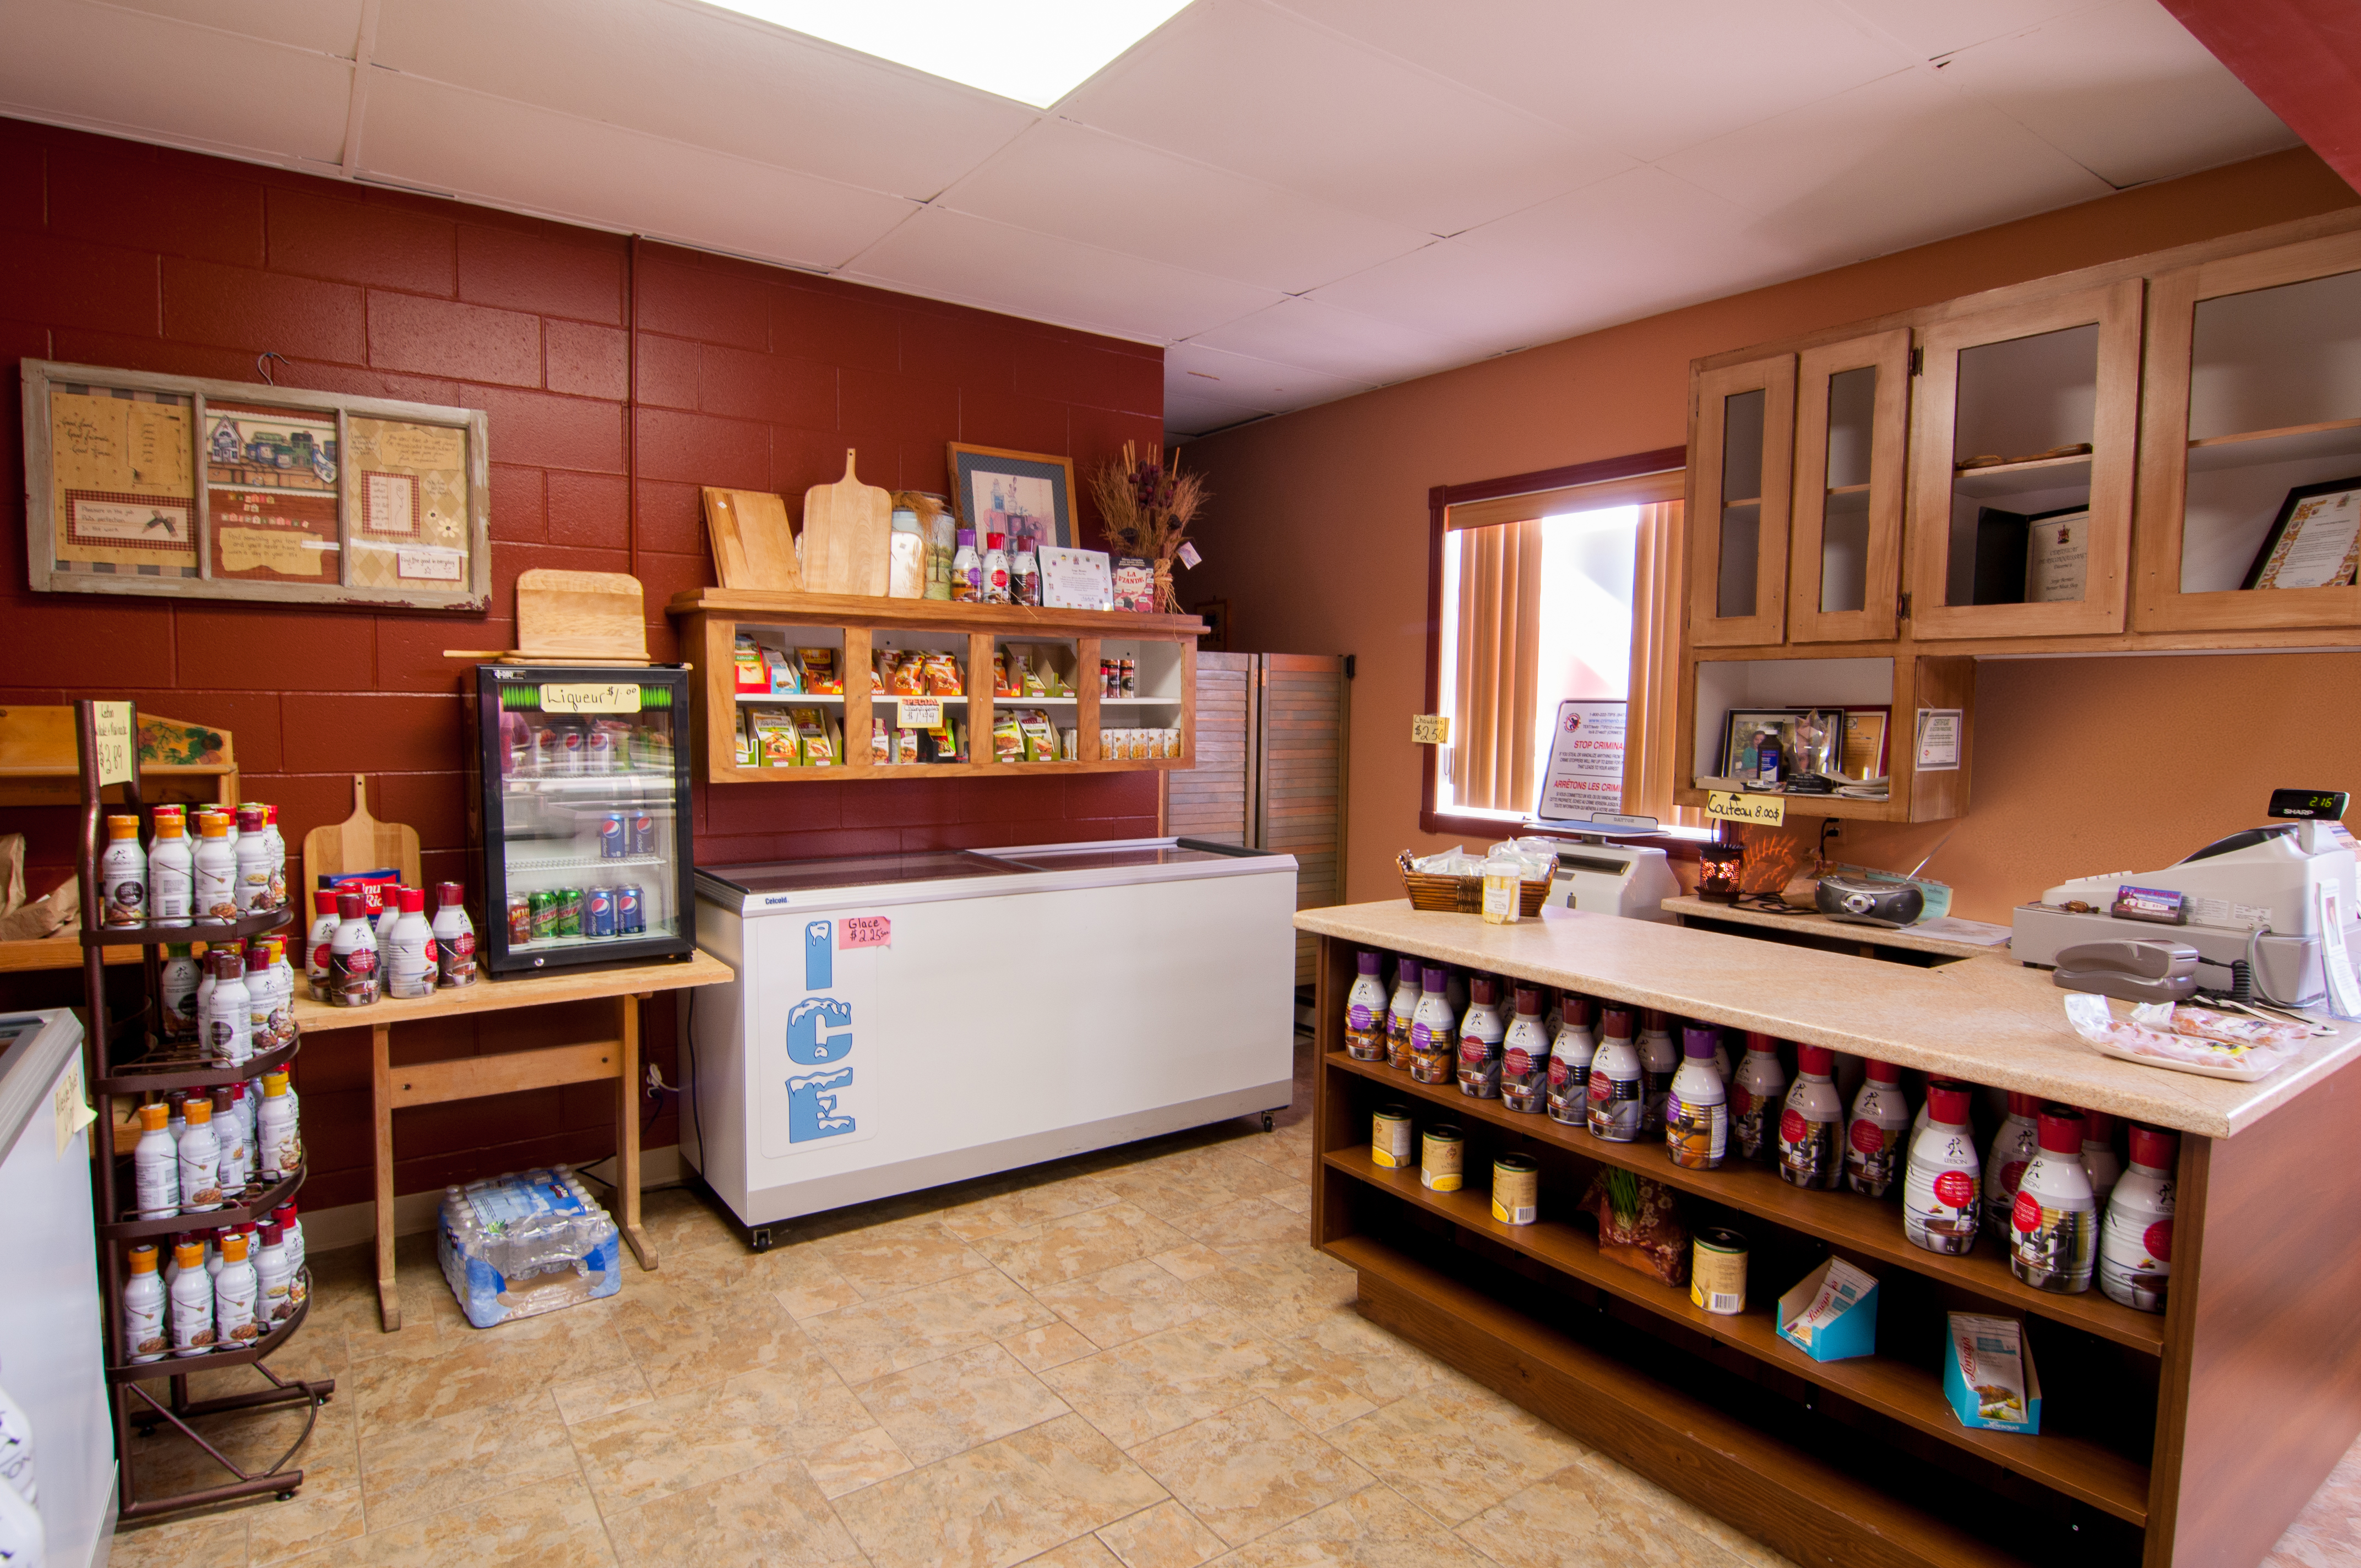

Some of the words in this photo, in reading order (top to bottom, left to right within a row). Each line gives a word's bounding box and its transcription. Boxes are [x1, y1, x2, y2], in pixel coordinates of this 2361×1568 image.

[1118, 575, 1145, 584] VIANDE
[546, 684, 606, 712] Liqueur
[901, 698, 939, 706] SPECIAL
[1415, 725, 1444, 741] $2.50
[1574, 741, 1592, 749] STOP
[1593, 741, 1623, 750] CRIMINA
[1553, 778, 1587, 790] ARRÊTONS
[1588, 782, 1600, 791] LES
[1601, 783, 1622, 792] CRIMI
[1755, 805, 1780, 821] 8.00$
[362, 883, 381, 895] inu
[366, 895, 383, 907] Ric
[512, 908, 530, 922] MU
[848, 918, 880, 929] Glace
[850, 928, 882, 943] $2.25
[785, 920, 856, 1144] ICE
